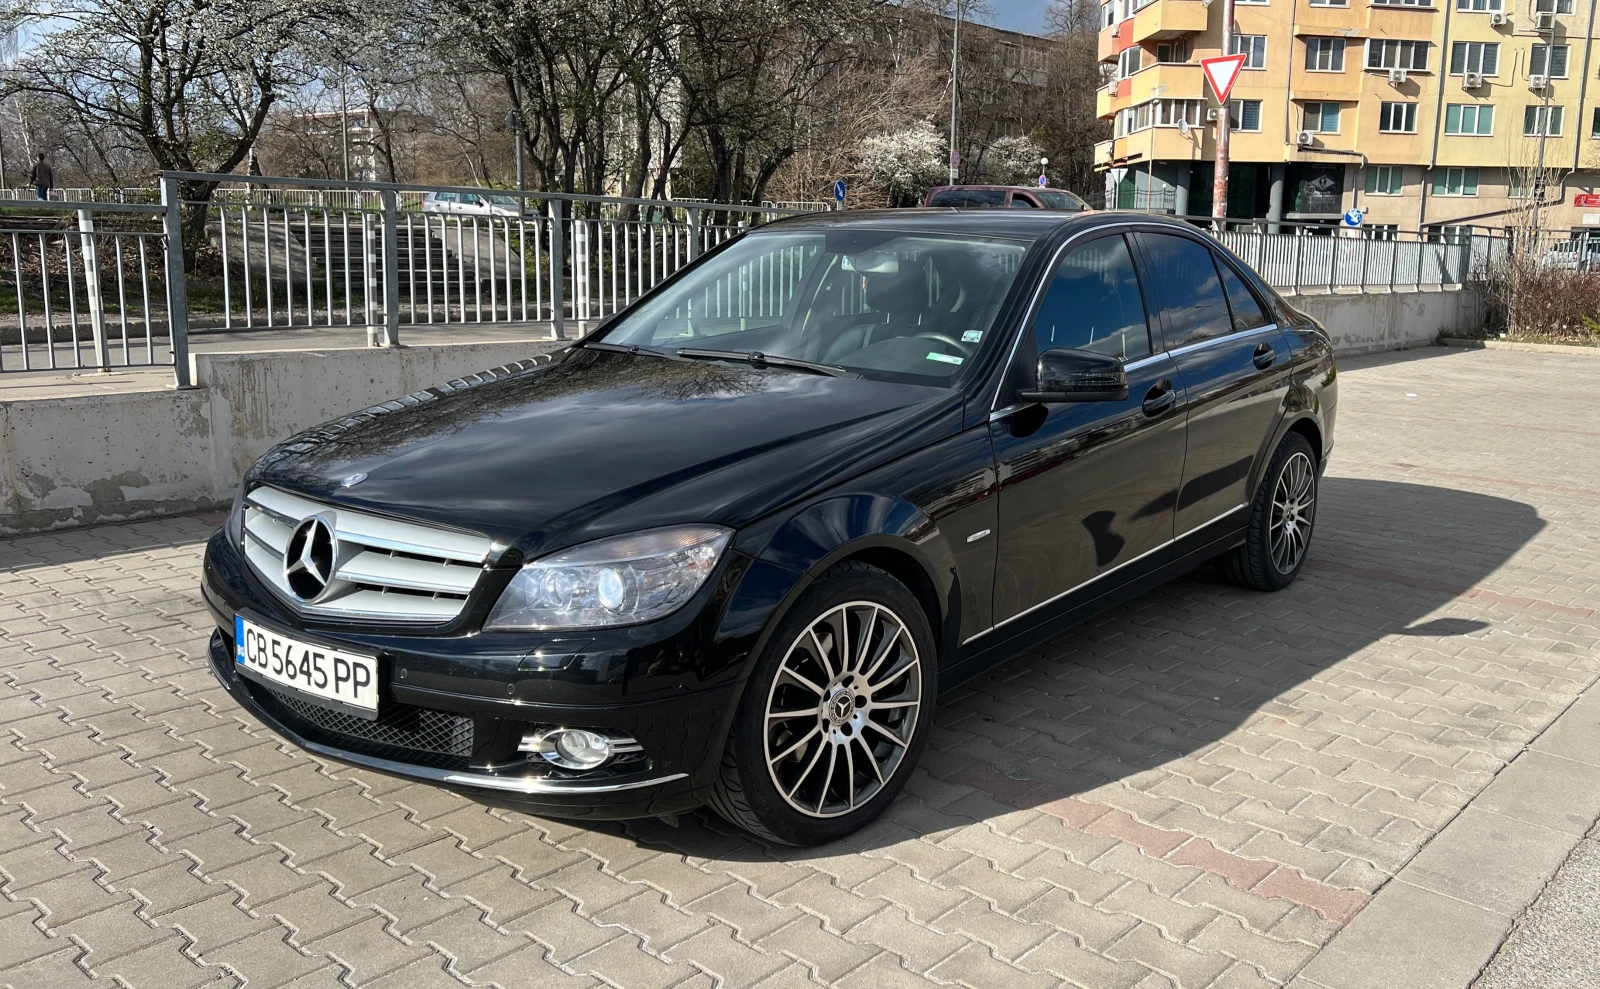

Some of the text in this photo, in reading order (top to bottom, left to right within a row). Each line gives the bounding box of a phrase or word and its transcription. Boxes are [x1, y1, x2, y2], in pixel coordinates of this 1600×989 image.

[246, 628, 371, 698] CB 5645 PP
